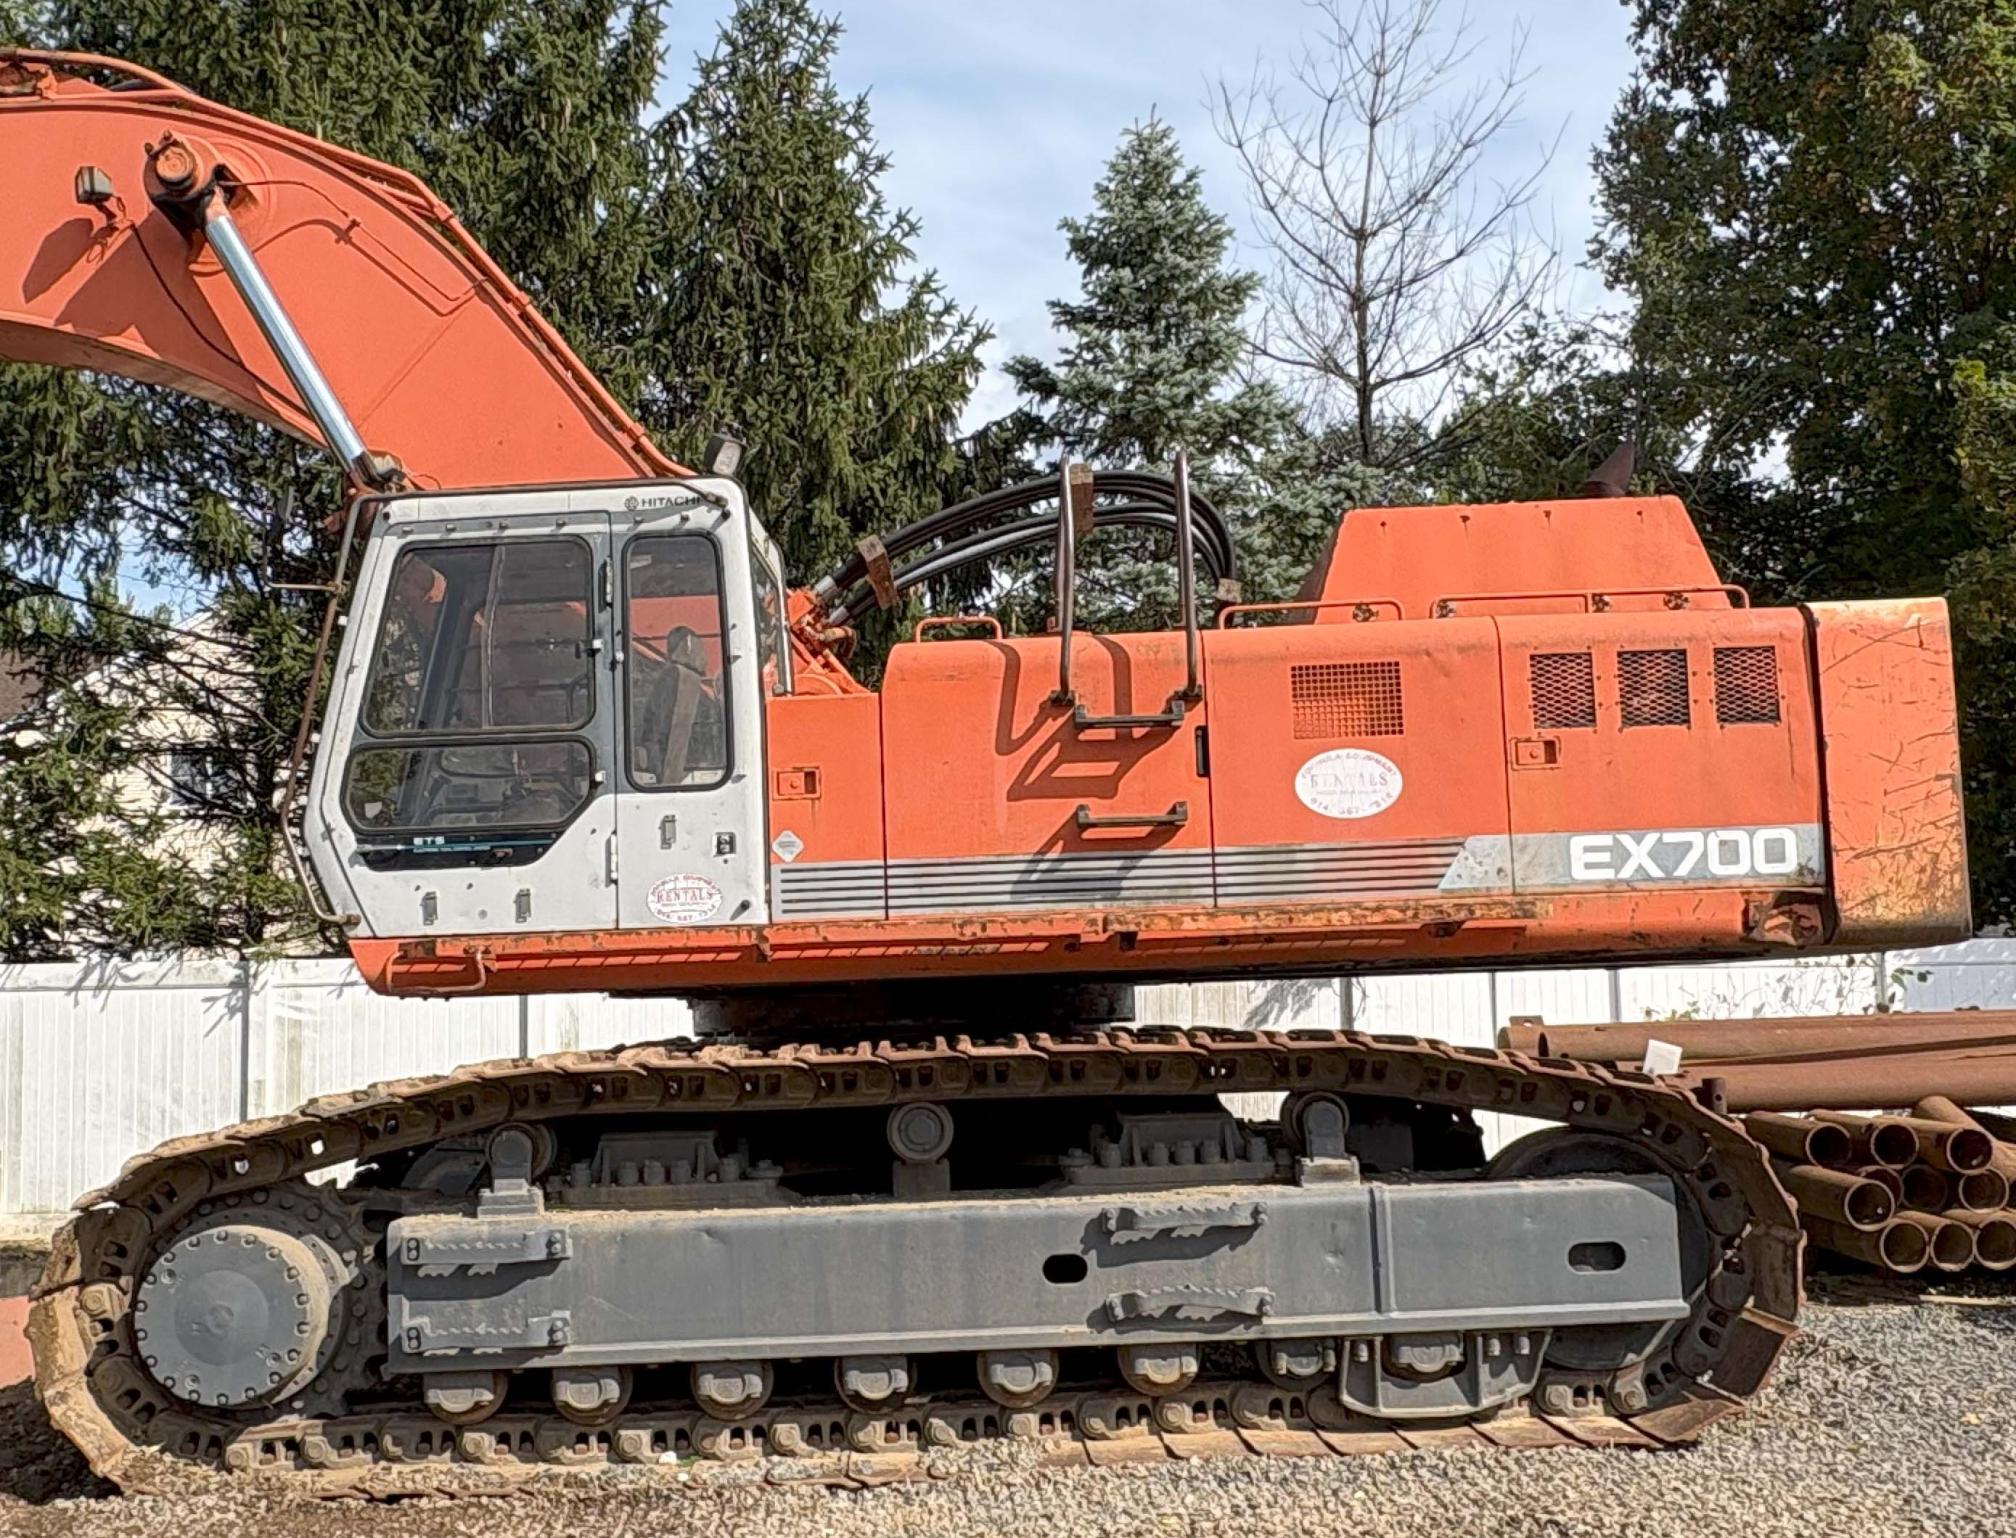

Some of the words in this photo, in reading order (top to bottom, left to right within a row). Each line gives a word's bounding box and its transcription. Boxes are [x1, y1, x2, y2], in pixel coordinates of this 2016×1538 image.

[642, 496, 701, 507] HITACHI
[1570, 828, 1797, 880] EX700
[656, 888, 714, 903] RENTALS
